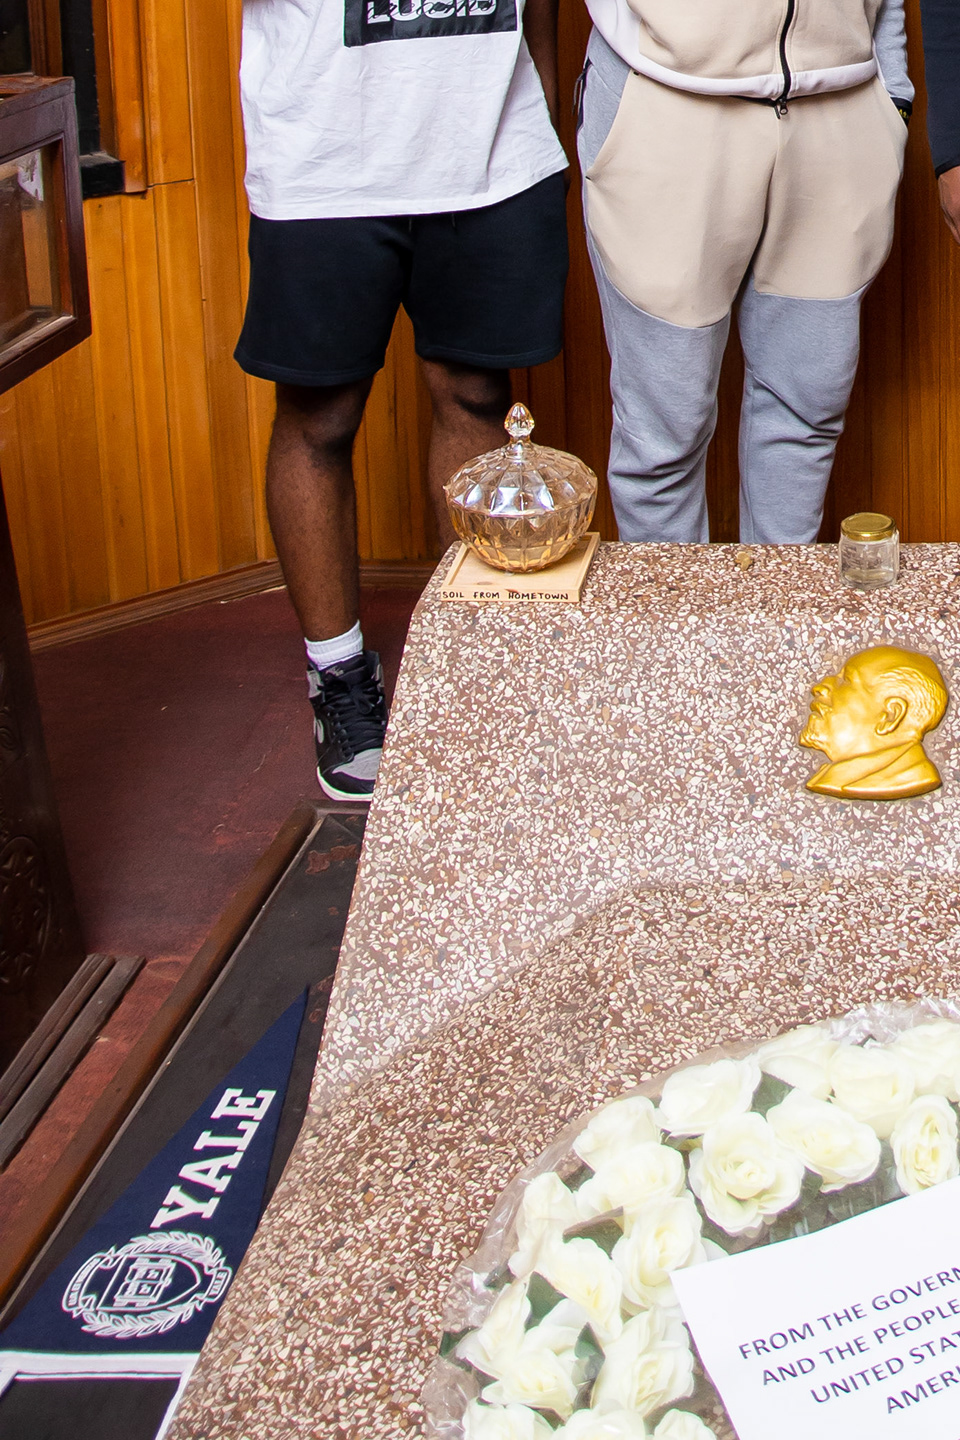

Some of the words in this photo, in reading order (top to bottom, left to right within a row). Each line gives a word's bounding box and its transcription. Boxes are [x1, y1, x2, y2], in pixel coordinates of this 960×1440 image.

[442, 591, 465, 599] SOIL
[473, 591, 500, 599] FROM
[508, 592, 569, 600] HOMETOWN
[150, 1087, 277, 1229] YALE
[738, 1323, 815, 1359] FROM
[817, 1303, 867, 1331] THE
[762, 1357, 816, 1385] AND
[819, 1336, 870, 1364] THE
[810, 1357, 904, 1403] UNITED
